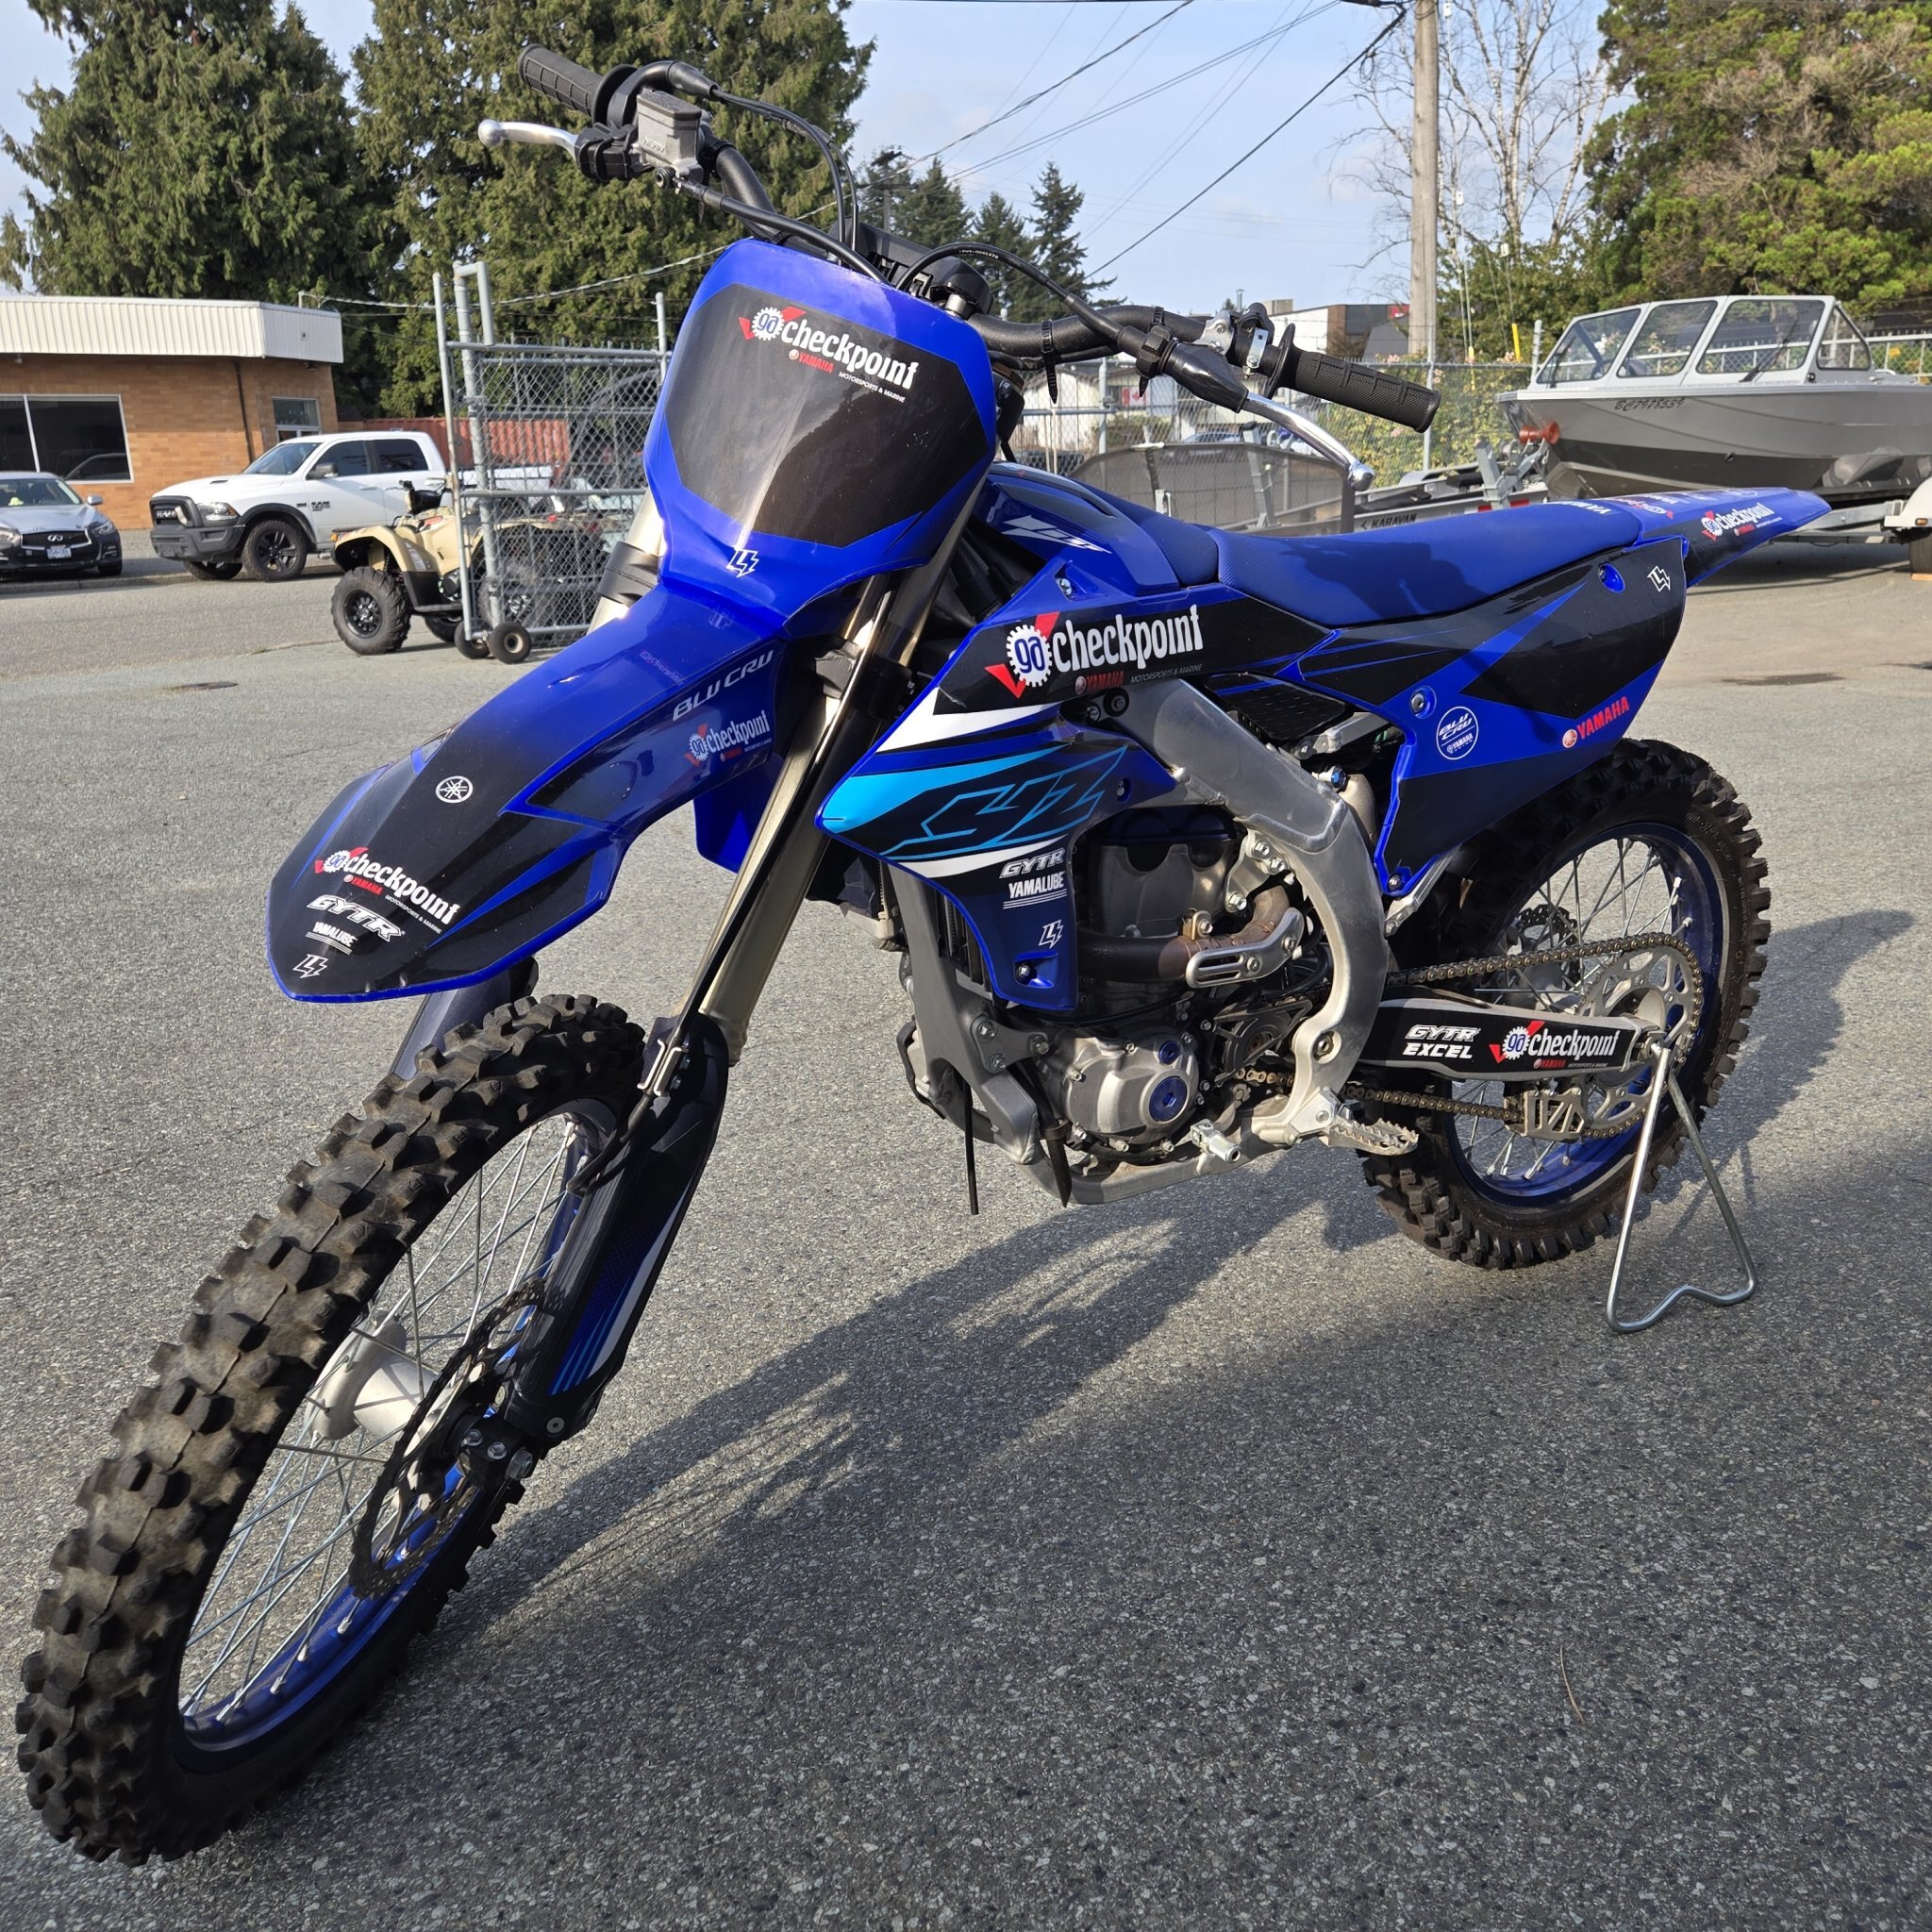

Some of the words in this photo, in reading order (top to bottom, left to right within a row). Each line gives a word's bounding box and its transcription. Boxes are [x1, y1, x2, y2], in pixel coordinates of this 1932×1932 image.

[781, 319, 919, 390] checkpoint
[799, 352, 834, 374] YAMAHA
[839, 372, 878, 391] MOTORSPORTS
[884, 389, 906, 403] MARINE
[1372, 513, 1417, 529] KARAVAN
[1715, 502, 1774, 530] checkpoint
[1053, 604, 1204, 673] checkpoint
[673, 679, 721, 722] BLU
[724, 650, 774, 688] CRU
[1086, 670, 1124, 692] YAMAHA
[1130, 670, 1173, 684] MOTORSPORTS
[1178, 663, 1203, 675] MARINE
[707, 709, 770, 753] checkpoint
[1576, 696, 1629, 740] YAMAHA
[1453, 733, 1474, 749] YAMAHA
[999, 847, 1065, 879] GYTR
[343, 854, 460, 924] checkpoint
[352, 876, 383, 895] YAMAHA
[1008, 872, 1064, 899] YAMALUBE
[307, 894, 402, 942] GYTR
[385, 894, 419, 919] MOTORSPORTS
[423, 918, 442, 934] MARINE
[312, 921, 357, 947] YAMALUBE
[1405, 1024, 1478, 1042] GYTR
[1528, 1028, 1621, 1061] checkpoint
[1403, 1042, 1473, 1059] EXCEL
[1541, 1059, 1566, 1068] YAMAHA
